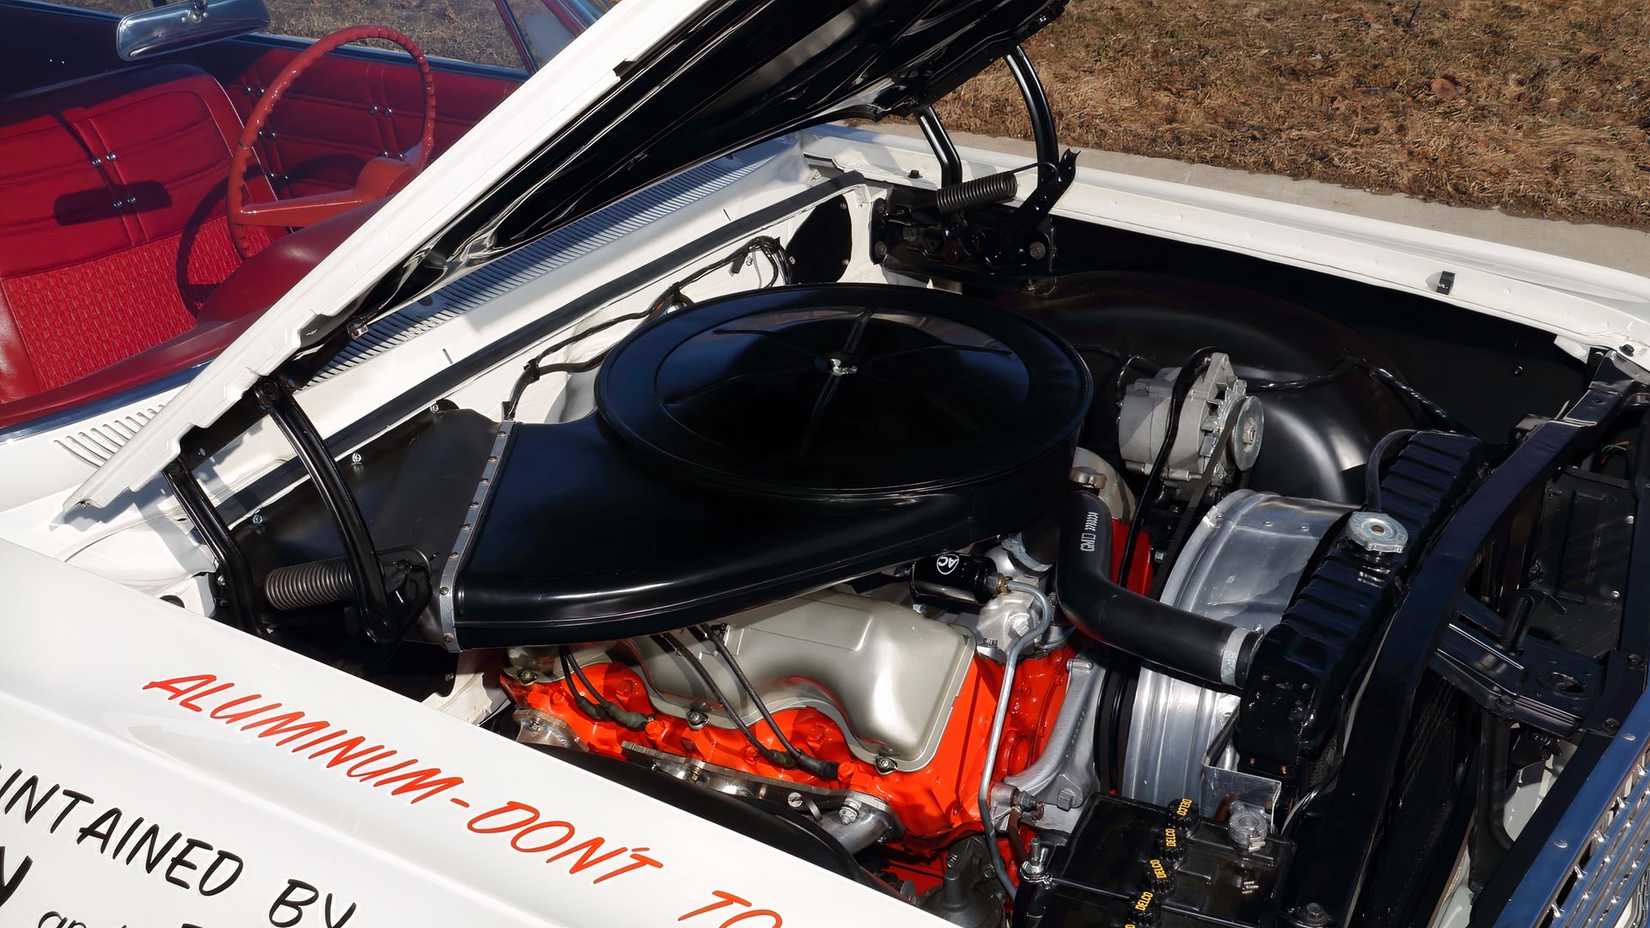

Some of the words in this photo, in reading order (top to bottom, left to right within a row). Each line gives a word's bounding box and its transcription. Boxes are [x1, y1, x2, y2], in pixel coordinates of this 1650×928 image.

[937, 556, 959, 569] AC
[1176, 798, 1193, 817] DELCO
[0, 764, 244, 897] INTAINED
[268, 878, 358, 928] BY
[1165, 828, 1177, 848] DELCO
[1150, 859, 1168, 880] DELCO
[1135, 891, 1154, 912] DELCO
